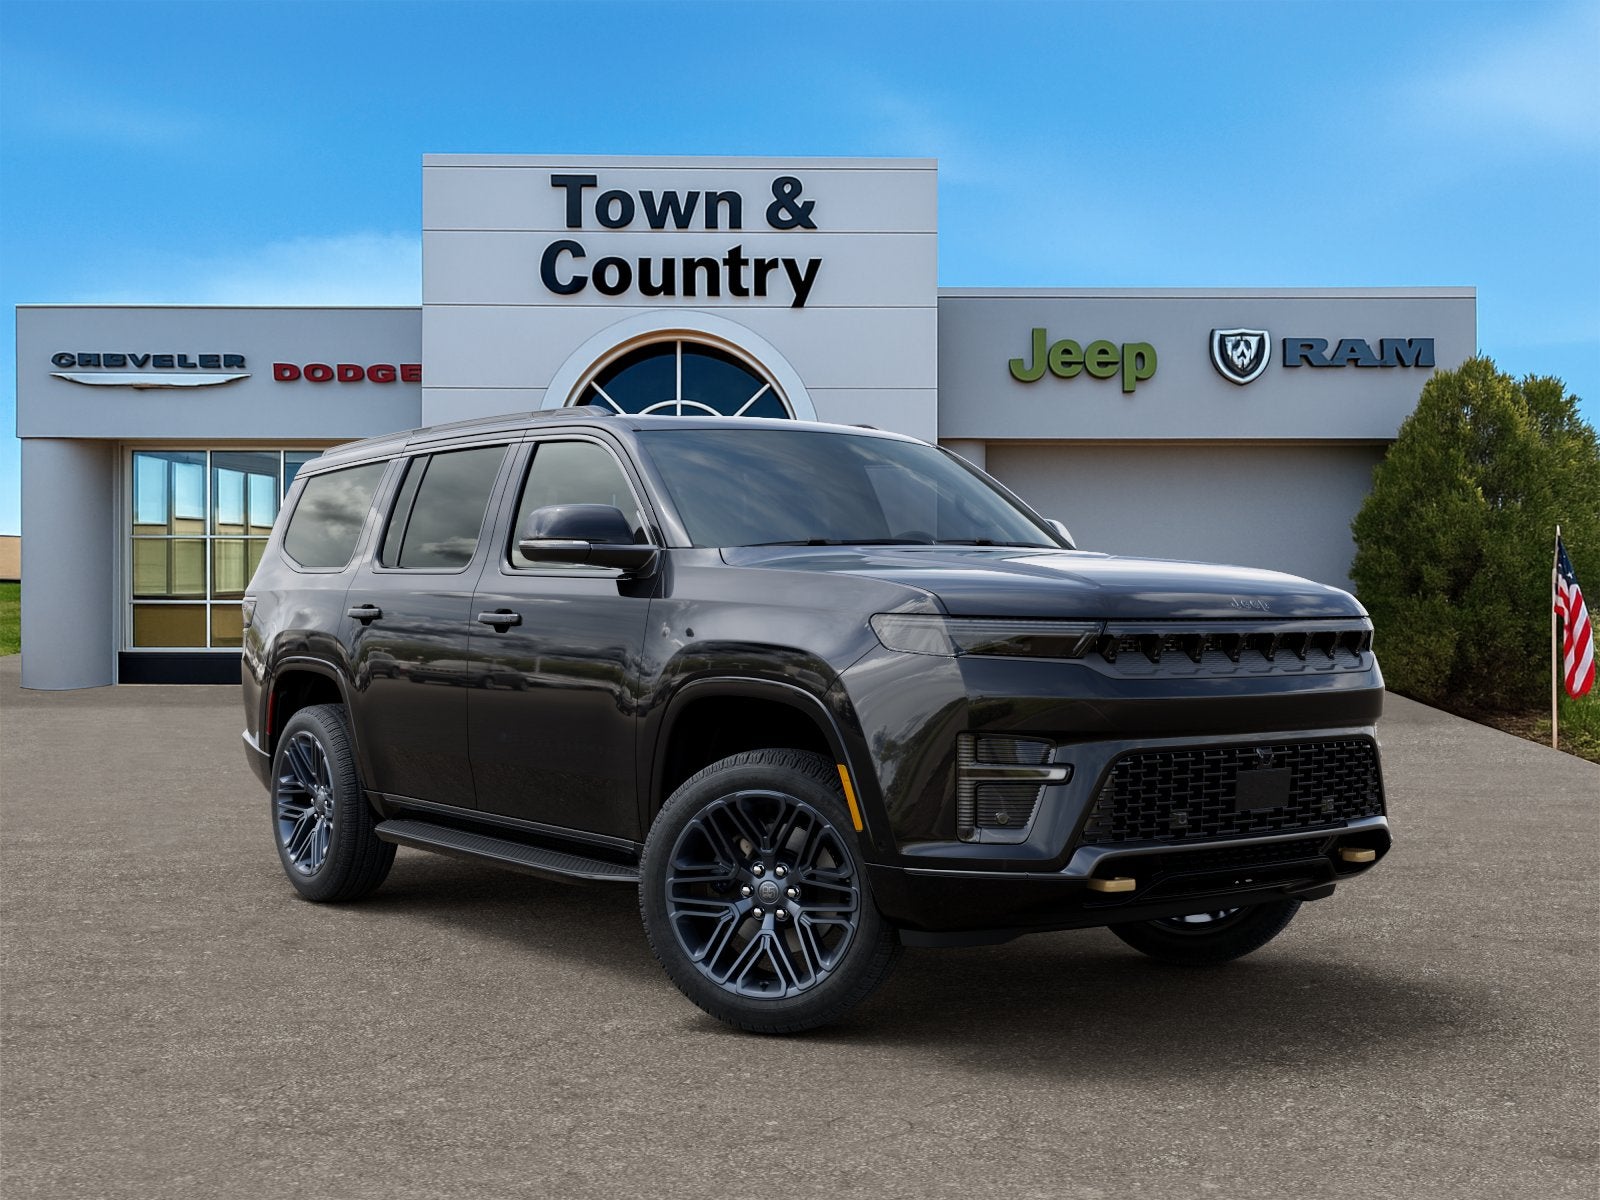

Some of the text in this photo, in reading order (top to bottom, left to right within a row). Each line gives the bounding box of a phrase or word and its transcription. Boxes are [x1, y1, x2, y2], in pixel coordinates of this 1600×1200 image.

[550, 174, 818, 229] Town &
[540, 239, 822, 308] Country
[273, 363, 422, 383] DODGE
[1009, 328, 1157, 393] Jeep
[1283, 337, 1436, 367] RAM
